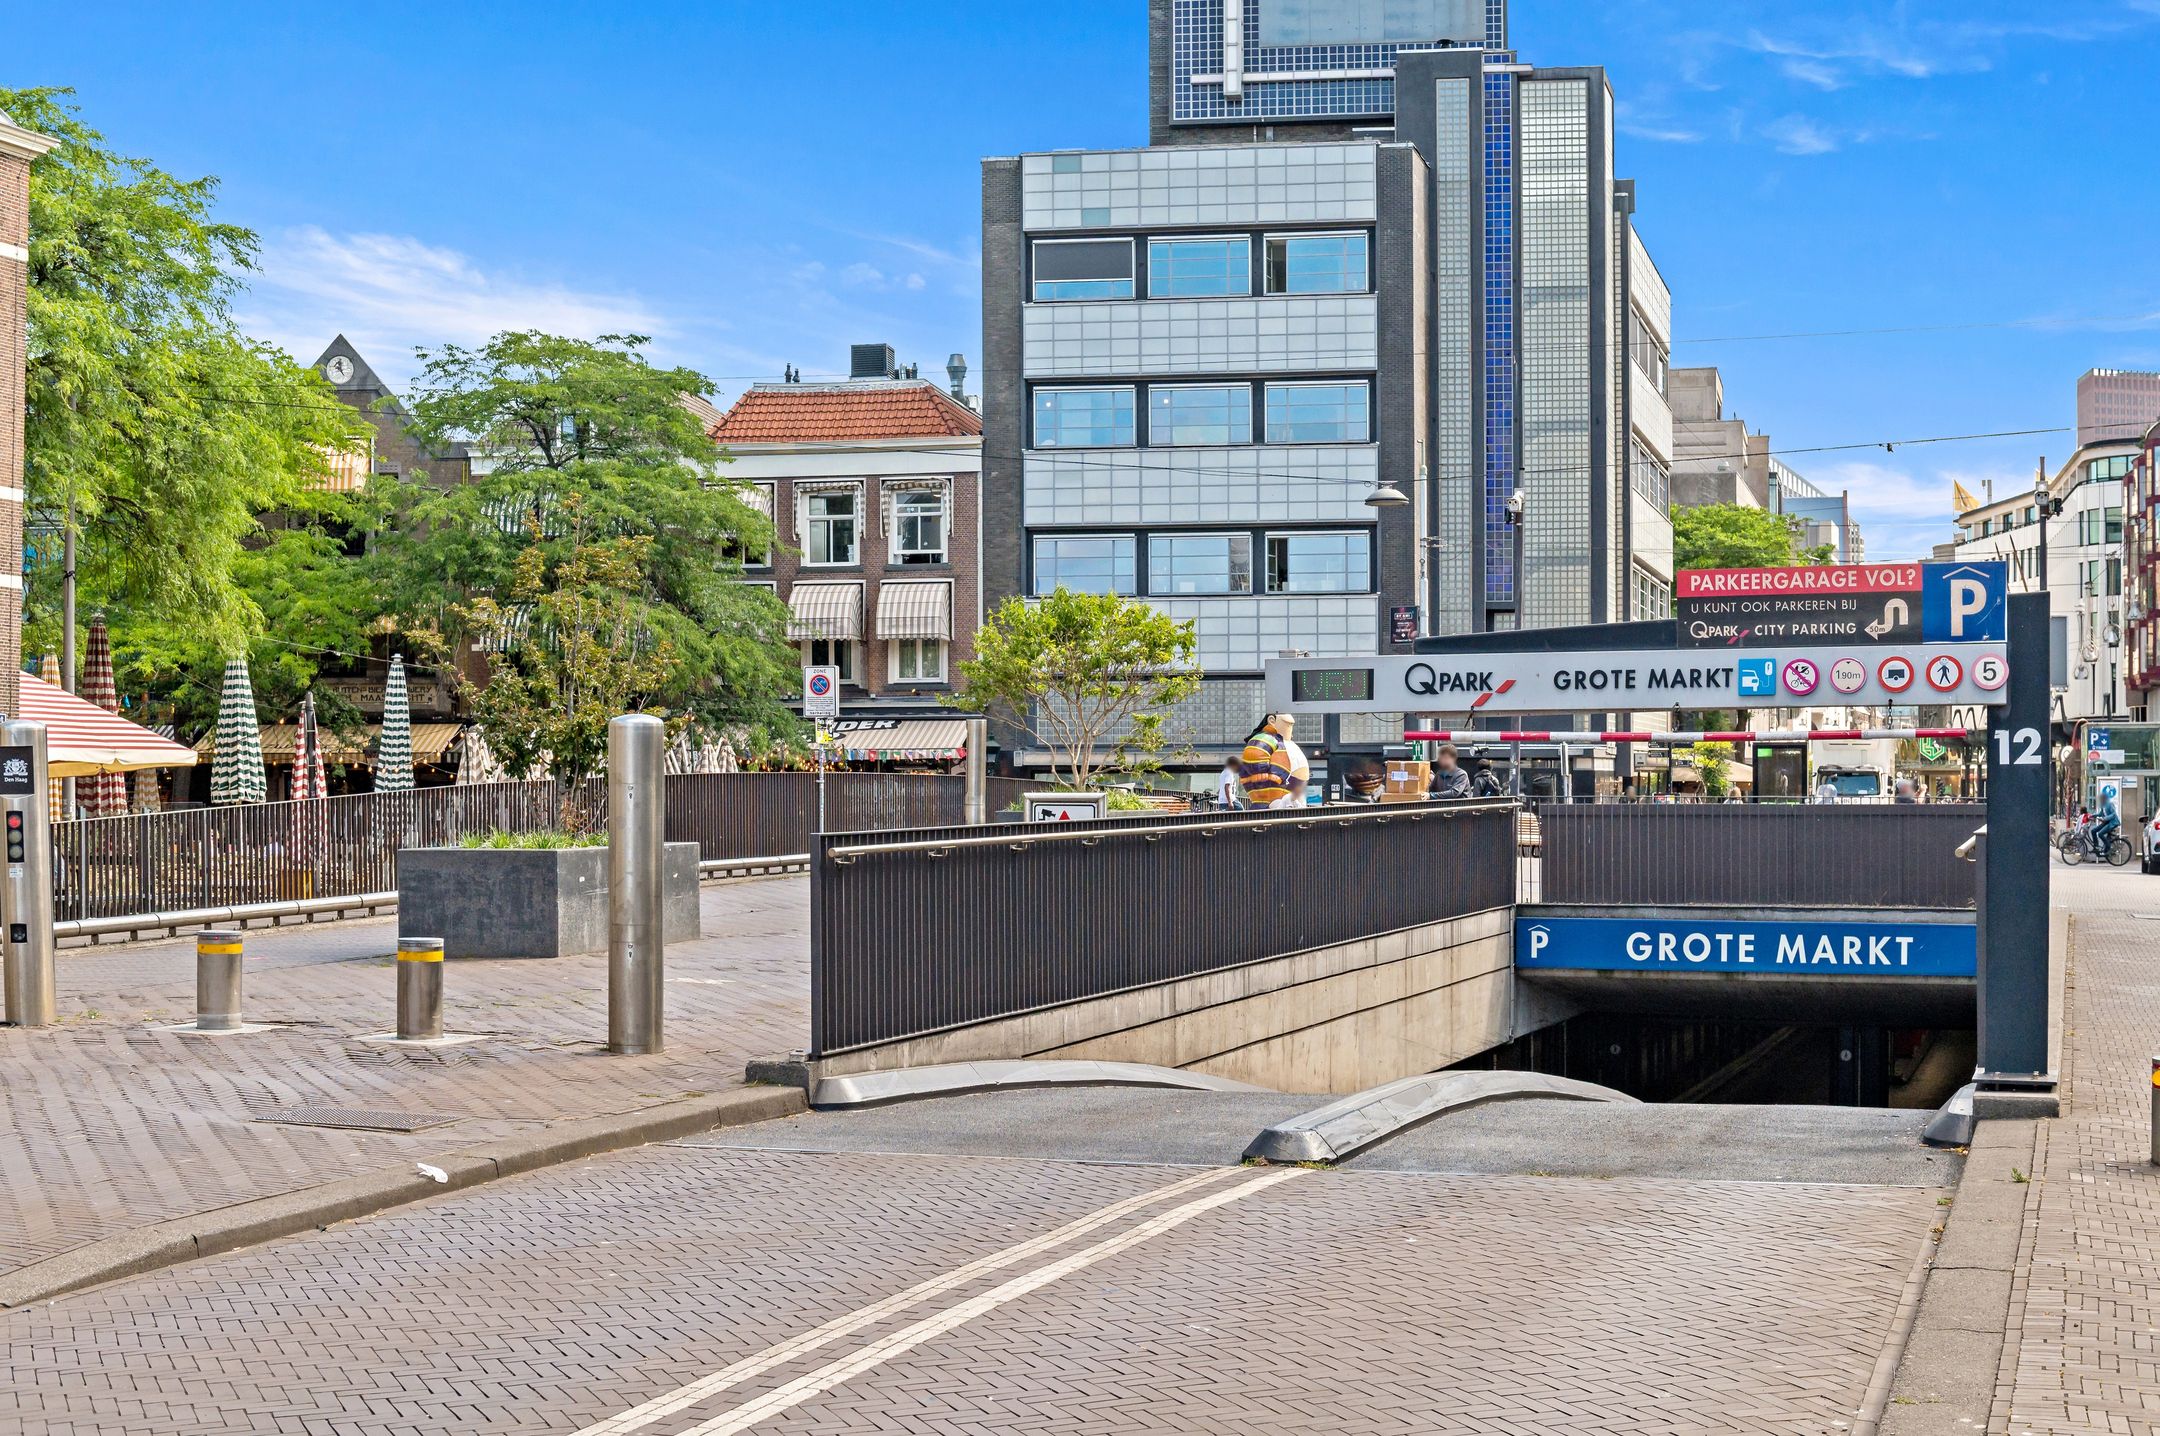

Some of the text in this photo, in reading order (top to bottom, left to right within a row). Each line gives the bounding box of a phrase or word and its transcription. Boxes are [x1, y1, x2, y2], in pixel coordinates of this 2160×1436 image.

[1690, 568, 1916, 591] PARKEERGARAGE VOL?
[1691, 599, 1857, 613] U KUNT OOK PARKEREN BIJ
[1950, 579, 1987, 636] P
[1755, 625, 1785, 636] CITY
[1792, 623, 1857, 635] PARKING
[1869, 625, 1886, 633] 50m
[1553, 669, 1636, 690] GROTE
[1648, 668, 1734, 689] MARKT
[1982, 661, 1997, 681] 5
[1994, 728, 2042, 765] 12
[1530, 930, 1549, 958] P
[1626, 931, 1914, 966] GROTE MARKT
